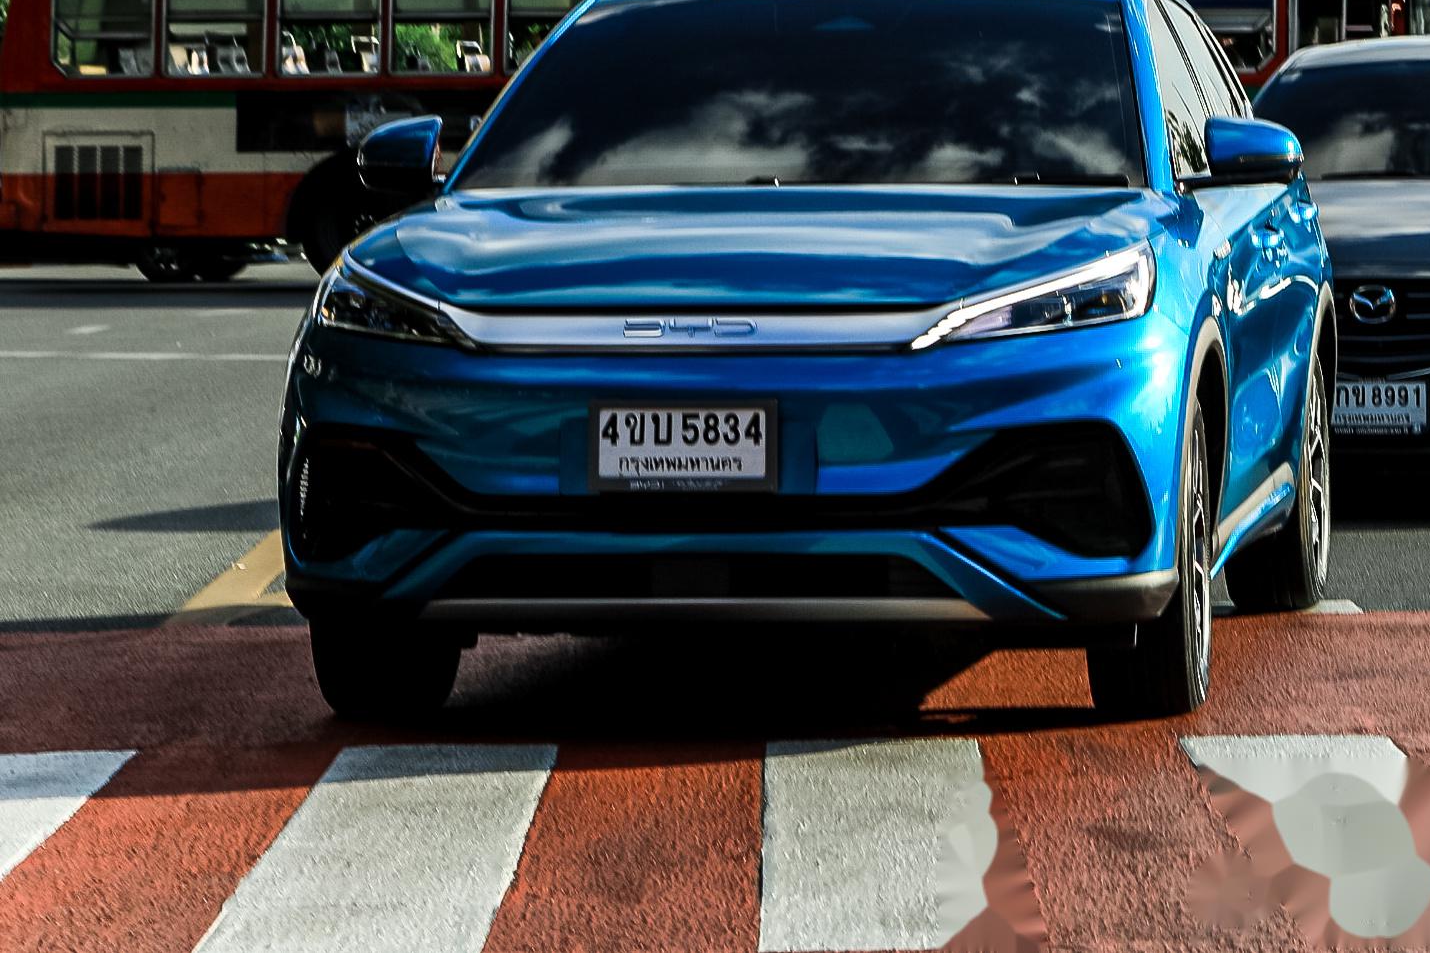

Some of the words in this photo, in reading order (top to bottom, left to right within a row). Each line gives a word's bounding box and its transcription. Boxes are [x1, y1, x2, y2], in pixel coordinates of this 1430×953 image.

[623, 318, 757, 338] BYD
[1372, 385, 1420, 407] 8991
[682, 412, 763, 447] 5834
[618, 456, 743, 476] กรุงเทพมหานคร
